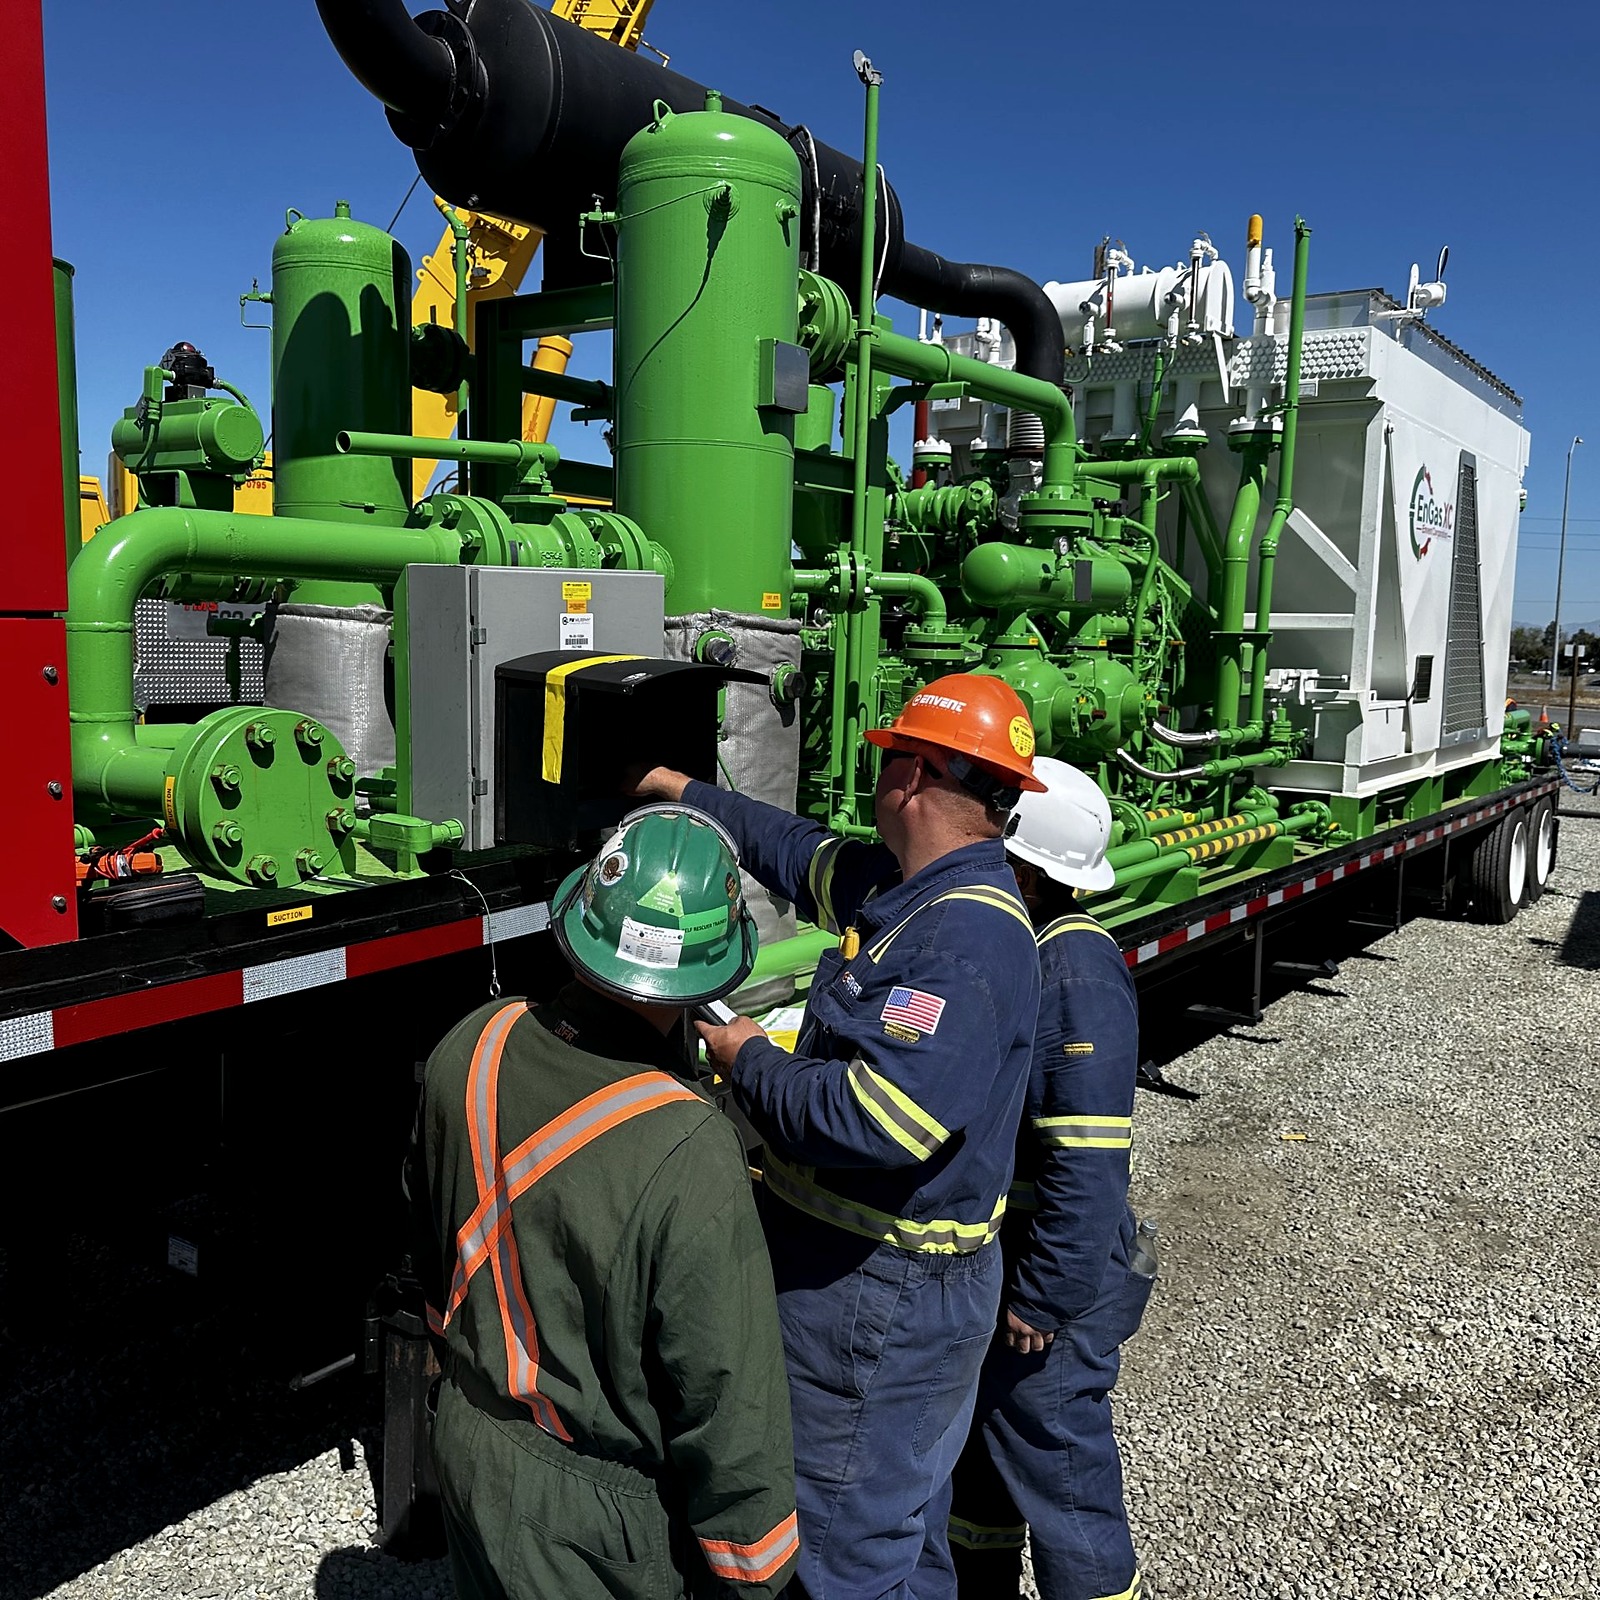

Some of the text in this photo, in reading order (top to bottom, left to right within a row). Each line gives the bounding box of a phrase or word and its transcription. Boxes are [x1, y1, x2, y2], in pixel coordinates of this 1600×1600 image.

[246, 481, 266, 489] 0795
[1417, 494, 1453, 530] EnGas XC
[273, 911, 303, 922] SUCTION
